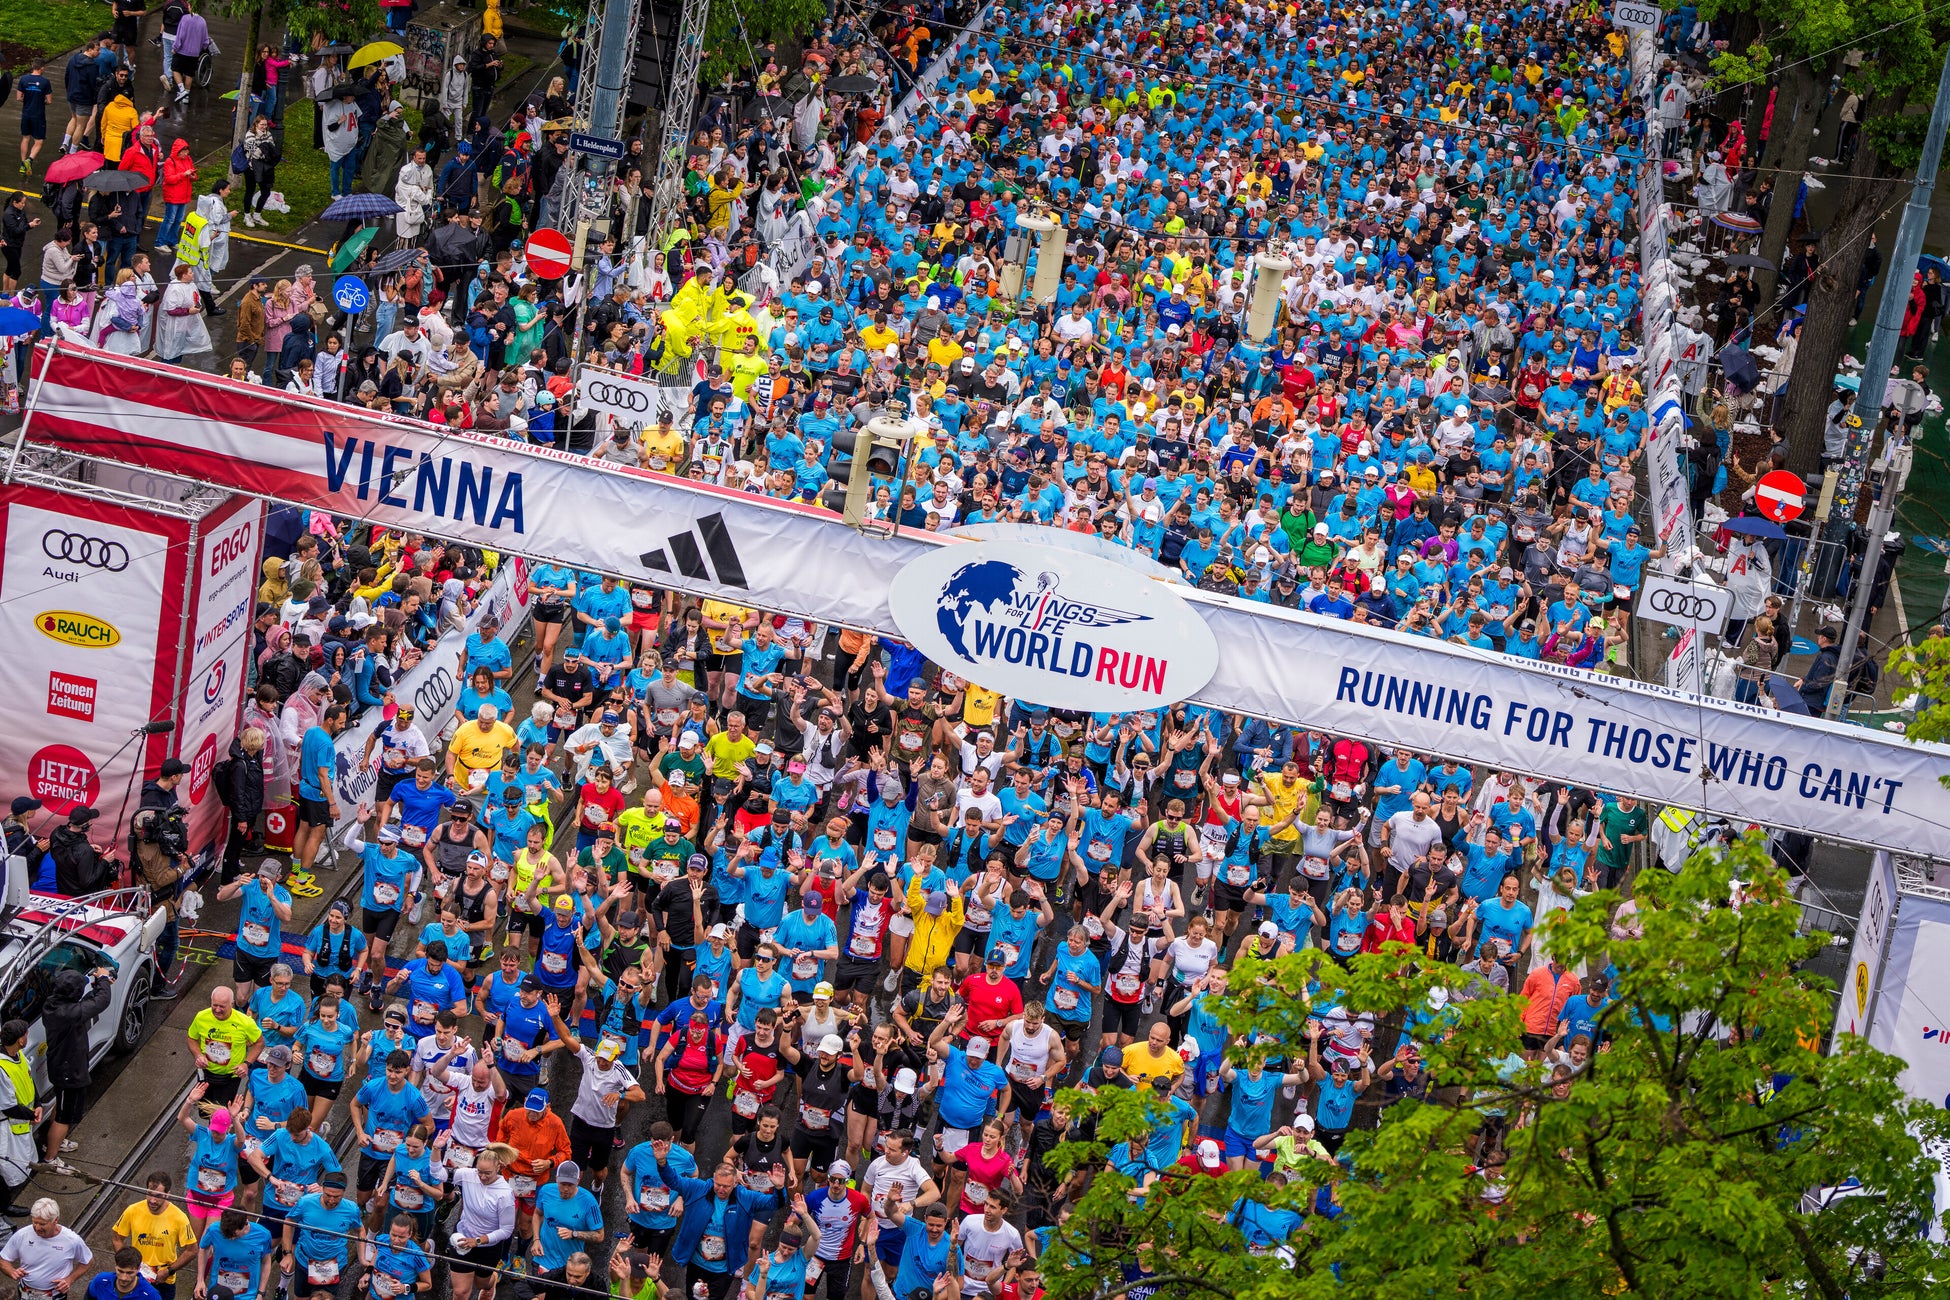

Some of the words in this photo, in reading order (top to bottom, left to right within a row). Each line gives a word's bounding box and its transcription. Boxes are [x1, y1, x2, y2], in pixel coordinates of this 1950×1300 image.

[583, 140, 618, 154] Heldenplatz
[324, 431, 525, 534] VIENNA
[211, 521, 251, 577] ERGO
[42, 567, 79, 583] Audi
[1005, 607, 1025, 619] FOR
[1014, 590, 1099, 623] WINGS
[57, 619, 111, 643] RAUCH
[204, 597, 249, 648] INTERSPORT
[52, 677, 94, 698] Kronen
[50, 693, 93, 715] Zeitung
[1336, 665, 1491, 731] RUNNING
[1503, 702, 1574, 748] FOR
[1587, 718, 1697, 774] THOSE
[1708, 743, 1789, 792] WHO
[38, 758, 91, 788] JETZT
[193, 745, 215, 780] JETZT
[37, 780, 88, 804] SPENDEN
